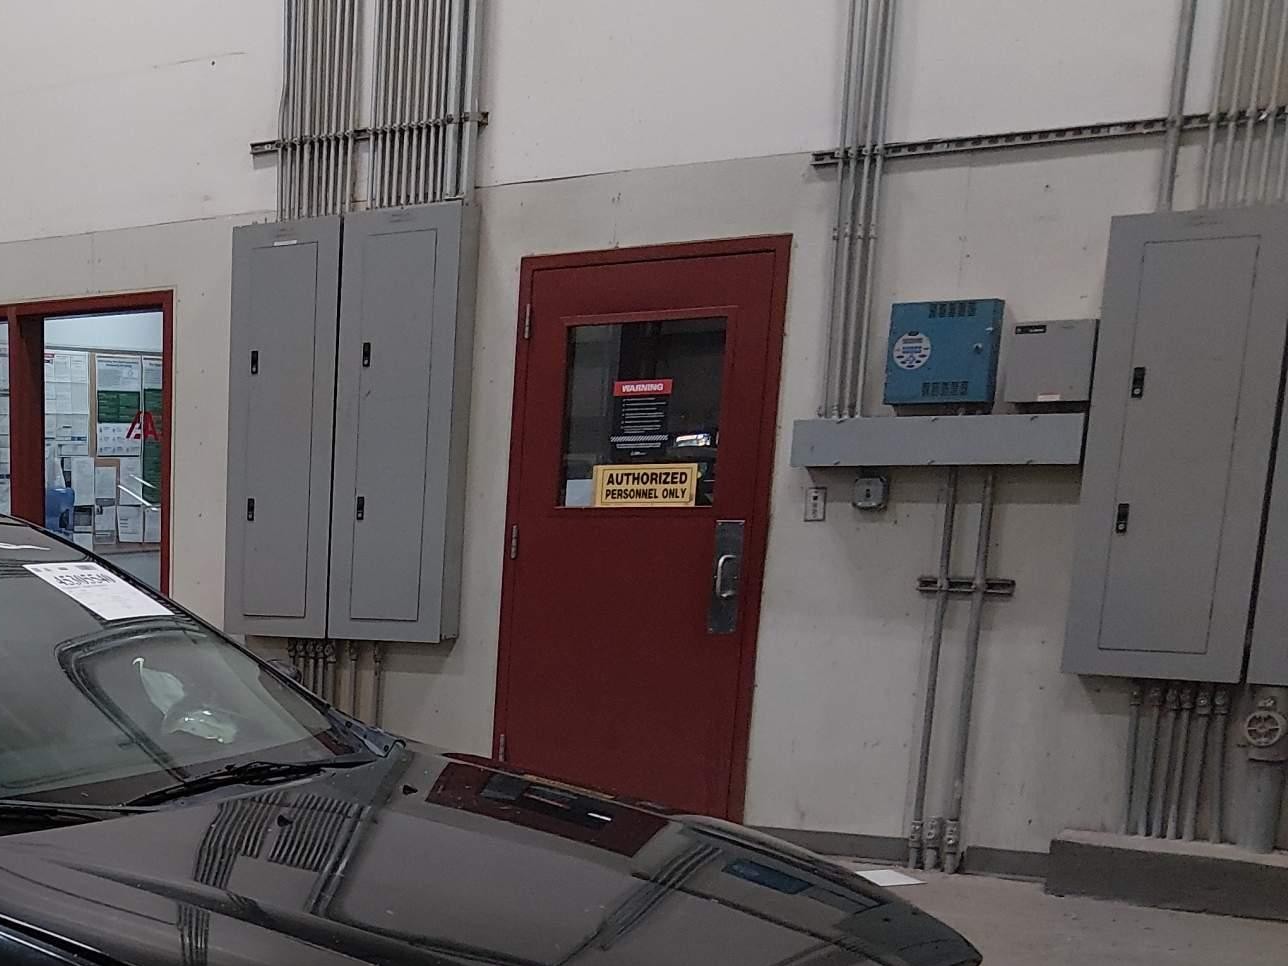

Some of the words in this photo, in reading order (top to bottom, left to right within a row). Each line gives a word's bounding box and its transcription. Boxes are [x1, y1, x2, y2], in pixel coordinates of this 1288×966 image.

[622, 383, 664, 393] WARNING
[606, 472, 688, 486] AUTHORIZED
[605, 488, 659, 500] PERSONNEL
[662, 487, 687, 499] ONLY
